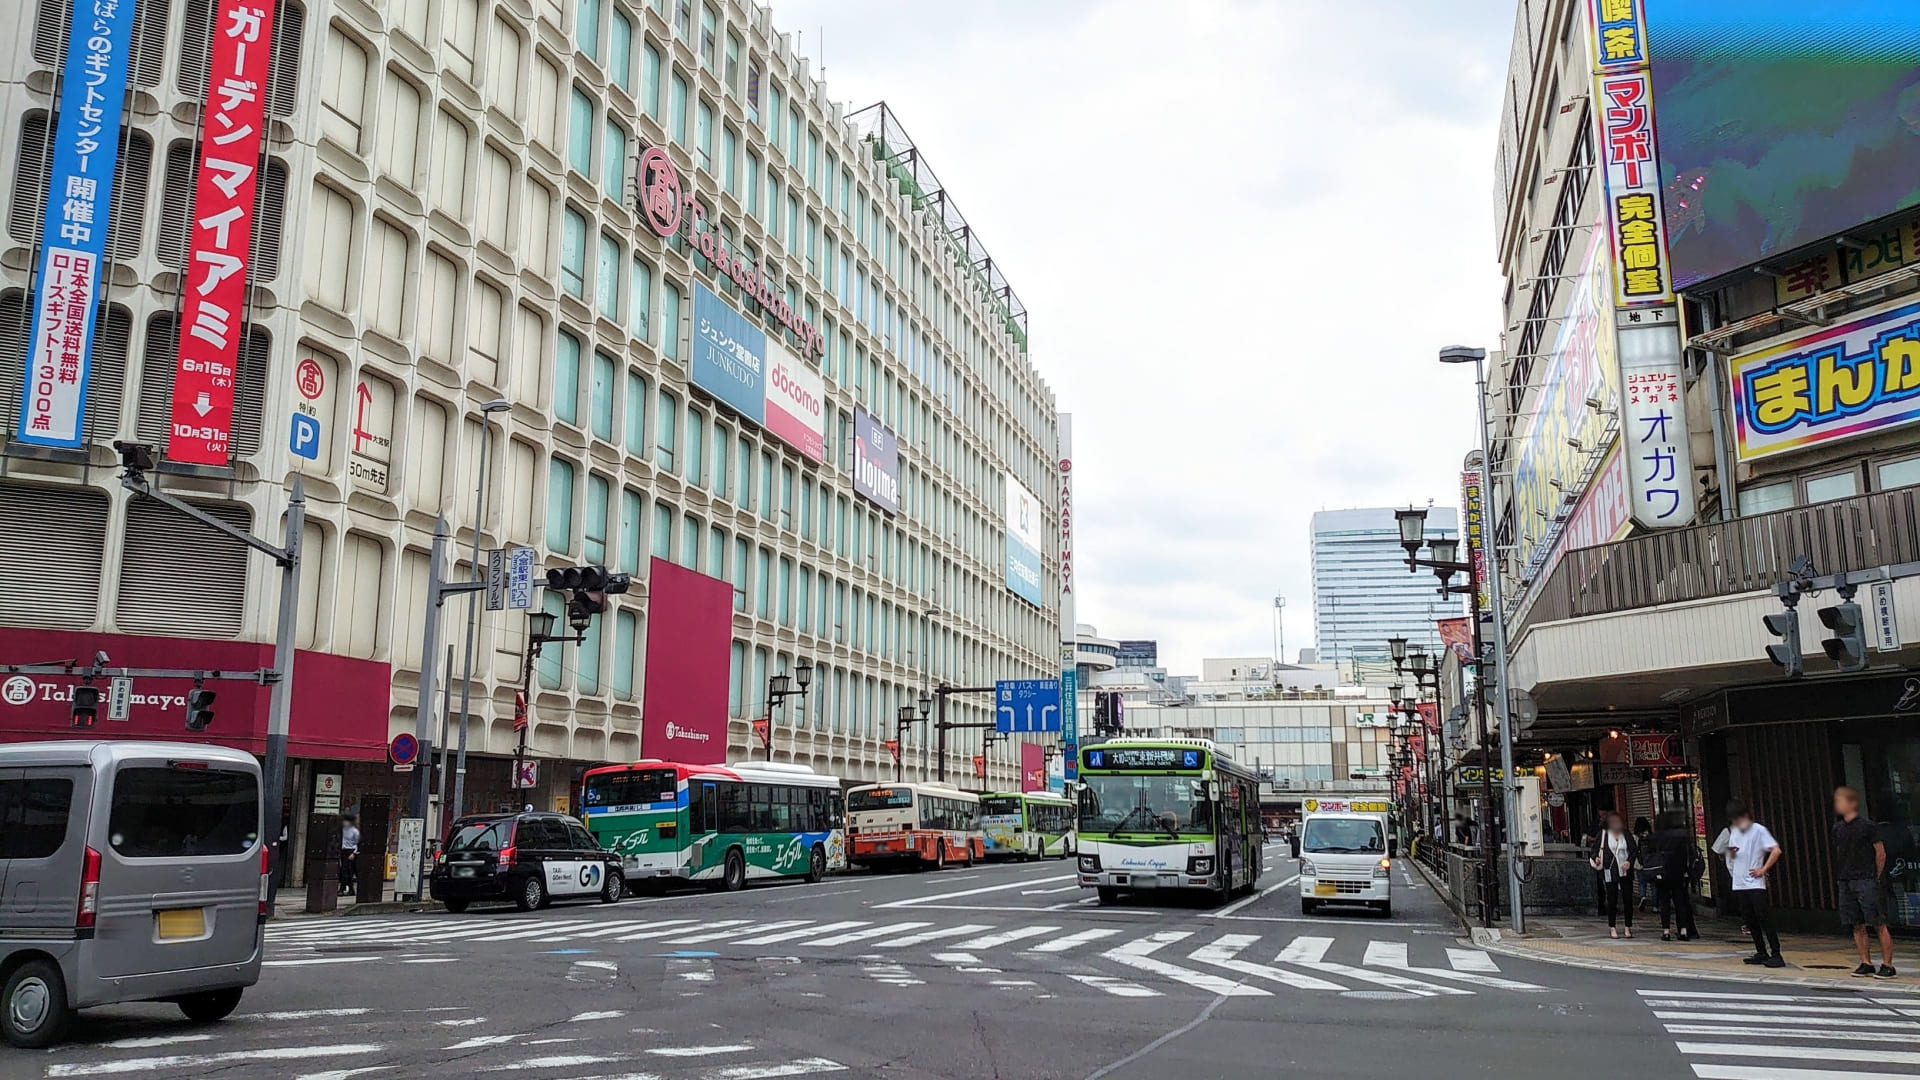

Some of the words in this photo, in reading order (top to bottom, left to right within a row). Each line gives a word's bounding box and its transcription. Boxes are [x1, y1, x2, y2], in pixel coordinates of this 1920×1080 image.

[1604, 79, 1647, 188] マンボー
[1617, 194, 1661, 295] 完全個室
[682, 193, 826, 357] Takashimaya
[58, 257, 90, 385] 日本全国送料無料
[1628, 310, 1664, 323] 地下
[32, 253, 70, 431] ローズギフト1300点
[700, 318, 760, 374] ジュンク堂書店
[183, 358, 231, 376] 6月15日
[706, 346, 754, 389] JUNKUDO
[772, 363, 820, 417] docomo
[1628, 373, 1676, 384] ジュエリー
[1629, 383, 1677, 394] ウォッチ
[1631, 393, 1678, 404] メガネ
[173, 424, 228, 441] 10月31日
[1639, 409, 1680, 519] オガワ
[1062, 475, 1071, 594] TAKASHIMAYA
[1357, 713, 1374, 723] JR
[580, 865, 600, 887] GO
